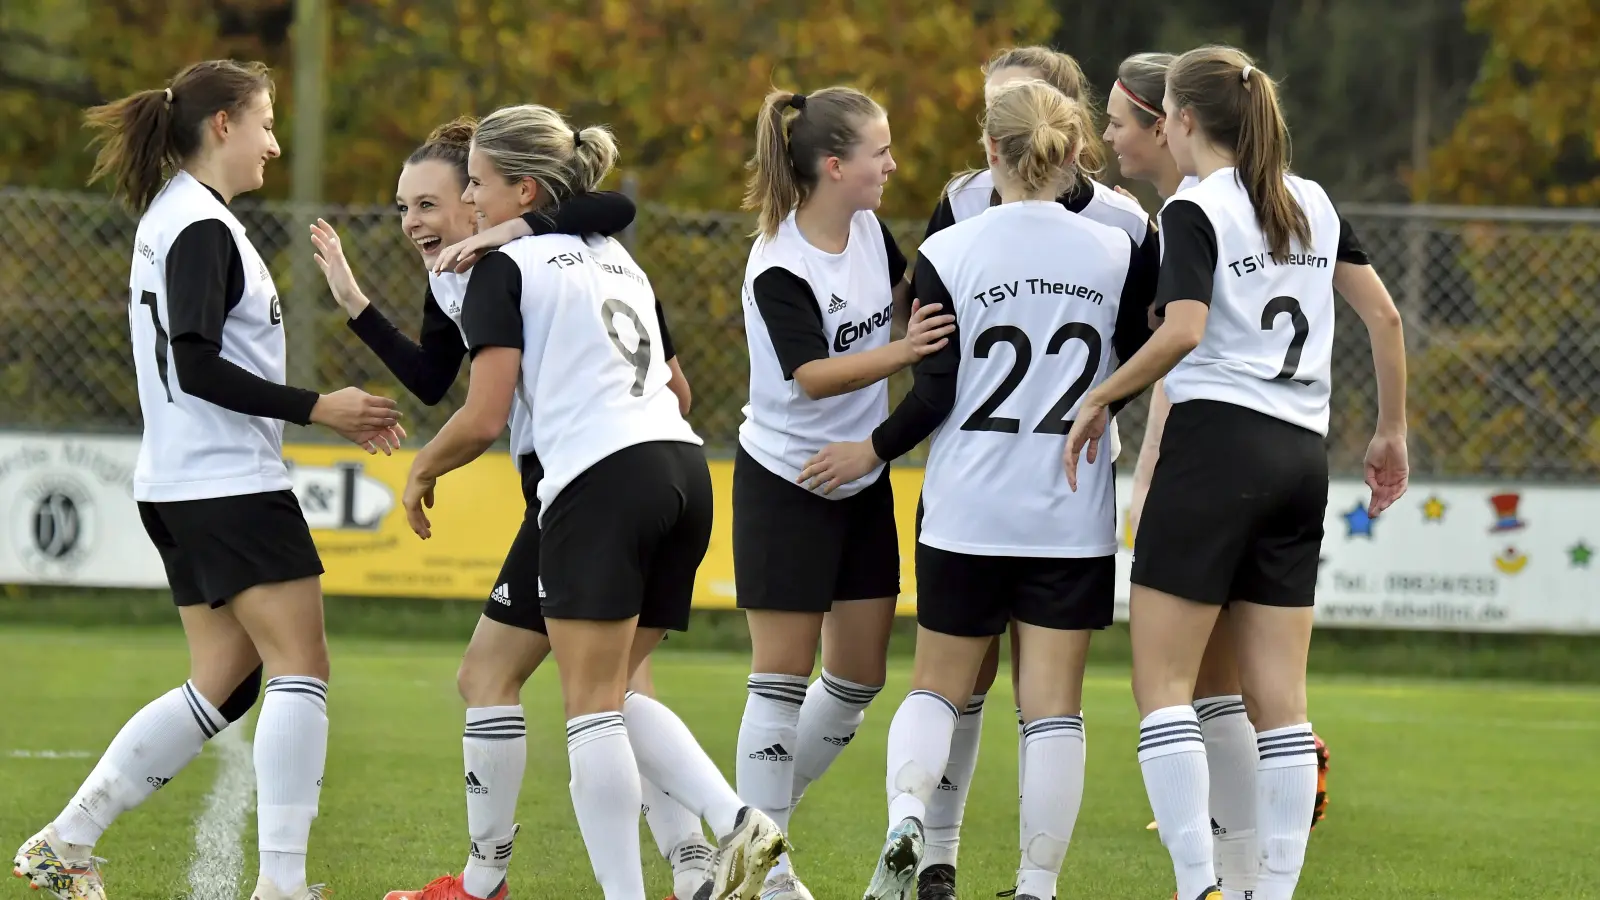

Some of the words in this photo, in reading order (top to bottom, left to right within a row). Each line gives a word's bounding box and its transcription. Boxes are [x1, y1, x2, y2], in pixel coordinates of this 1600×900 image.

[546, 251, 584, 270] TSV
[1228, 252, 1265, 278] TSV
[1267, 251, 1328, 269] Teuern
[973, 280, 1020, 309] TSV
[1025, 278, 1104, 306] Theuern
[600, 298, 651, 398] 9
[1260, 295, 1317, 387] 2
[960, 321, 1103, 435] 22
[748, 752, 794, 762] adidas
